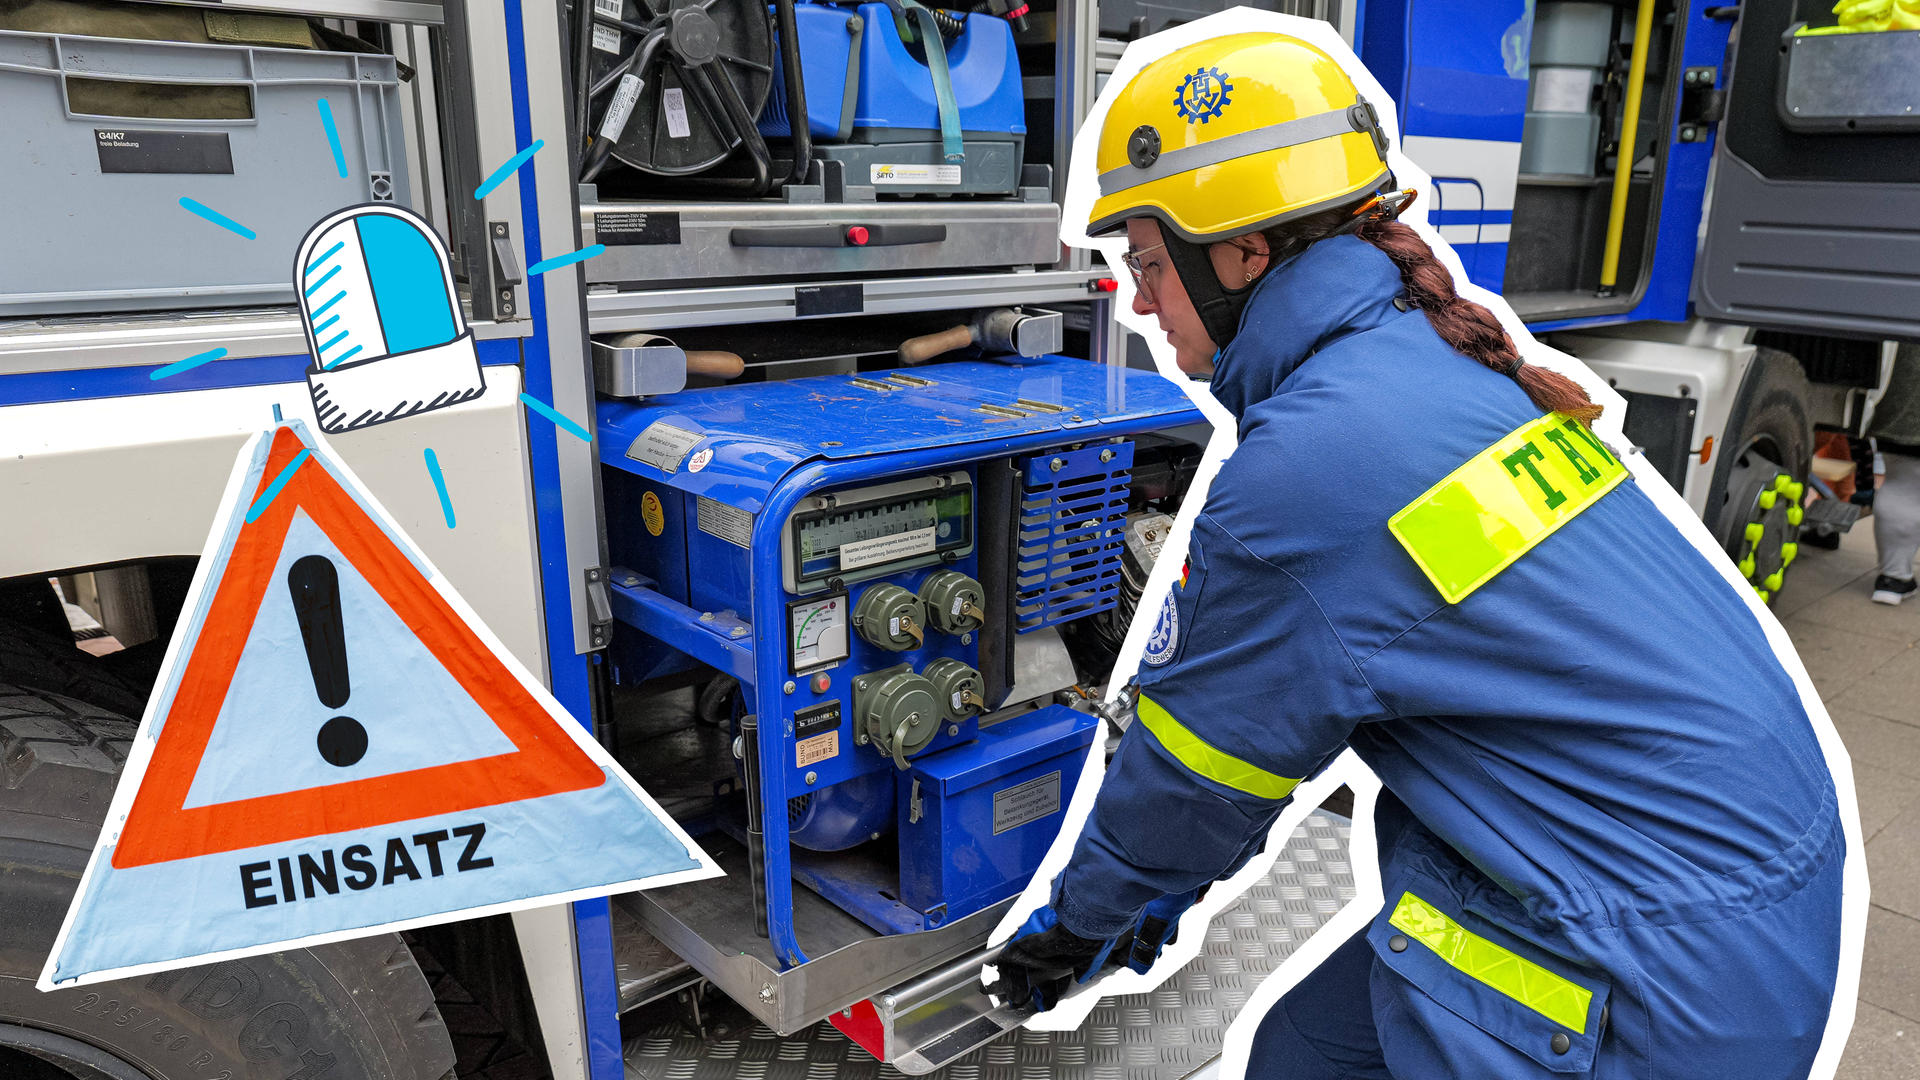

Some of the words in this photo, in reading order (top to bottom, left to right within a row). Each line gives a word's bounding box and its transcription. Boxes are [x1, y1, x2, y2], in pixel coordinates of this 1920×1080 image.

[98, 132, 125, 140] G4/K7
[1010, 791, 1035, 804] Schlauch
[996, 813, 1023, 826] Werkzeug
[1024, 808, 1034, 816] und
[1035, 800, 1057, 812] Zubehör
[240, 822, 494, 910] EINSATZ
[72, 992, 190, 1053] 295/80
[186, 1050, 214, 1072] R
